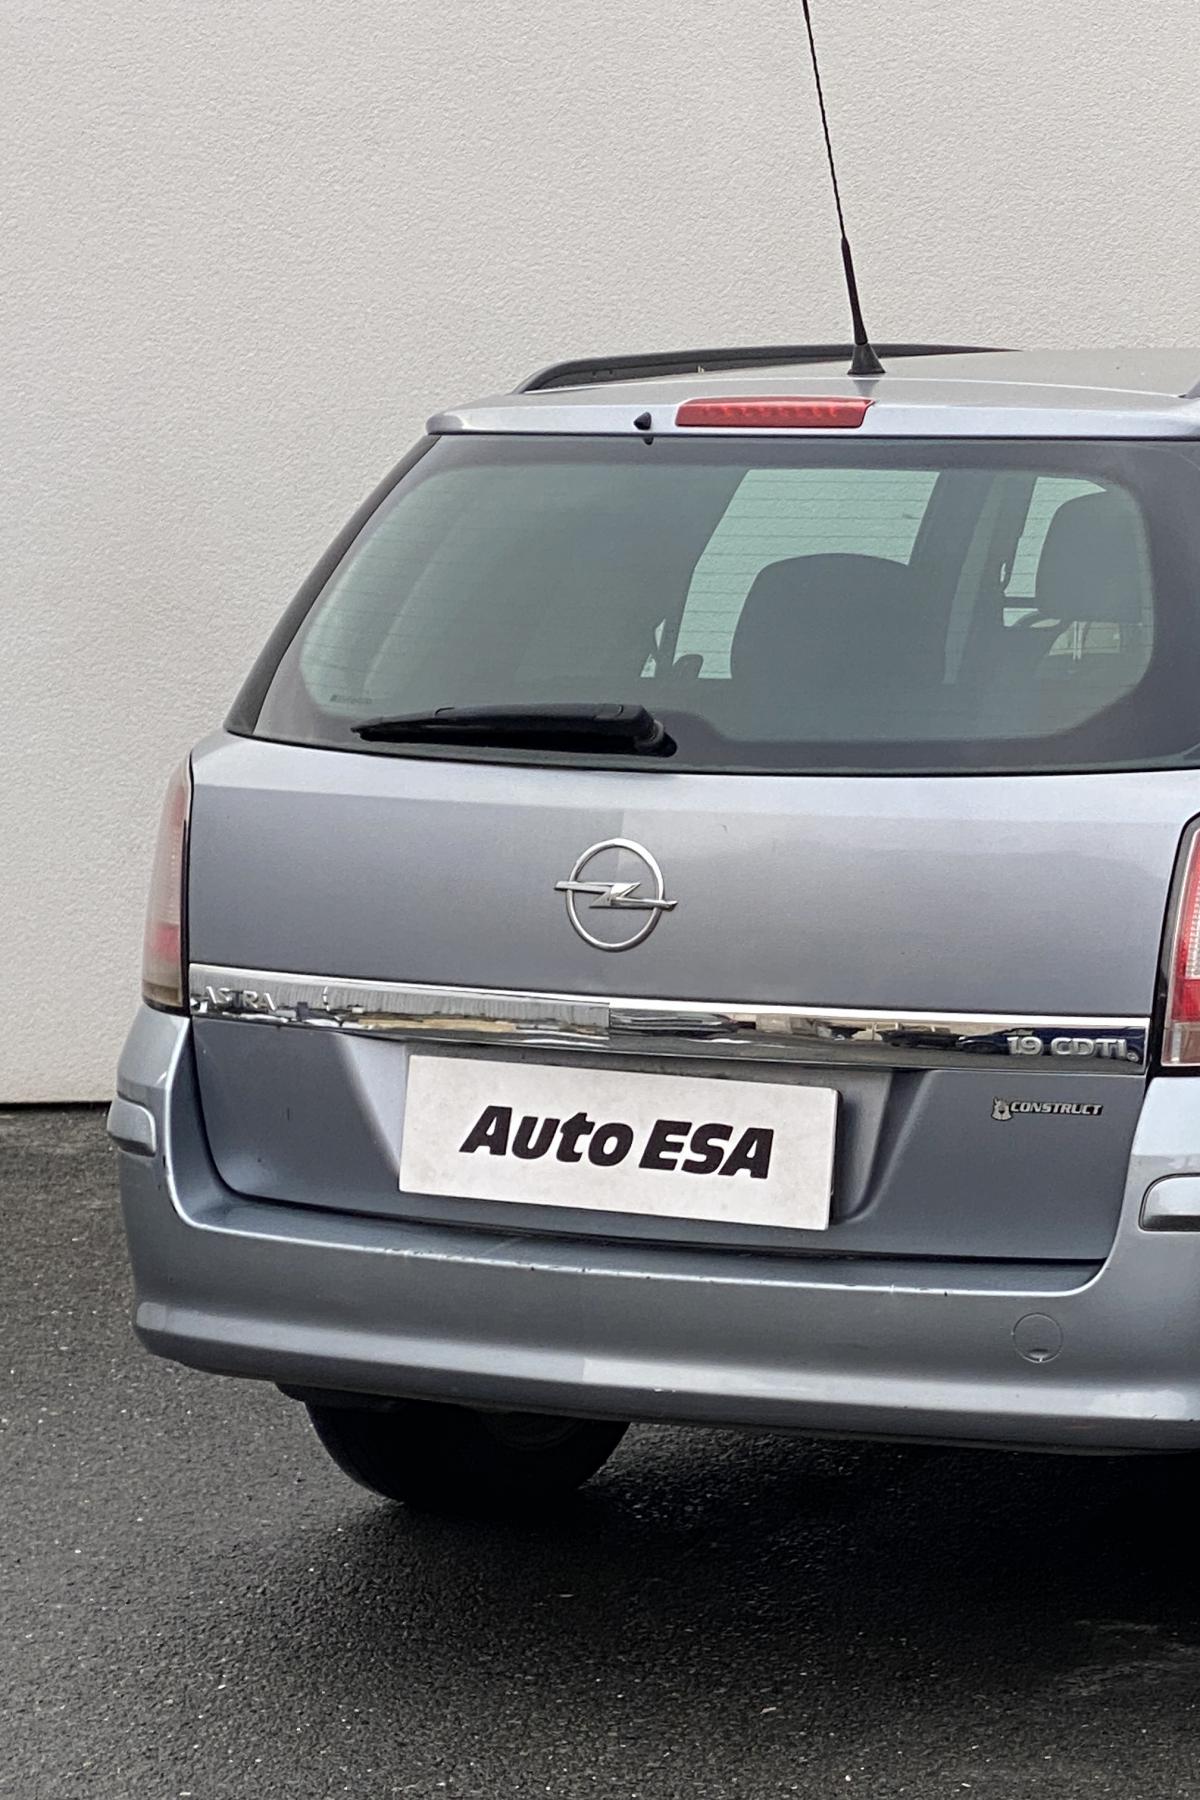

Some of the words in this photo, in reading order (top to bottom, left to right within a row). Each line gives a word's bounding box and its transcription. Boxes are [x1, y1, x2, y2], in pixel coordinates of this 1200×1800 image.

[1050, 1037, 1127, 1057] CDTI
[1010, 1101, 1102, 1115] CONSTRUCT
[459, 1105, 634, 1167] Auto
[638, 1119, 775, 1179] ESA
